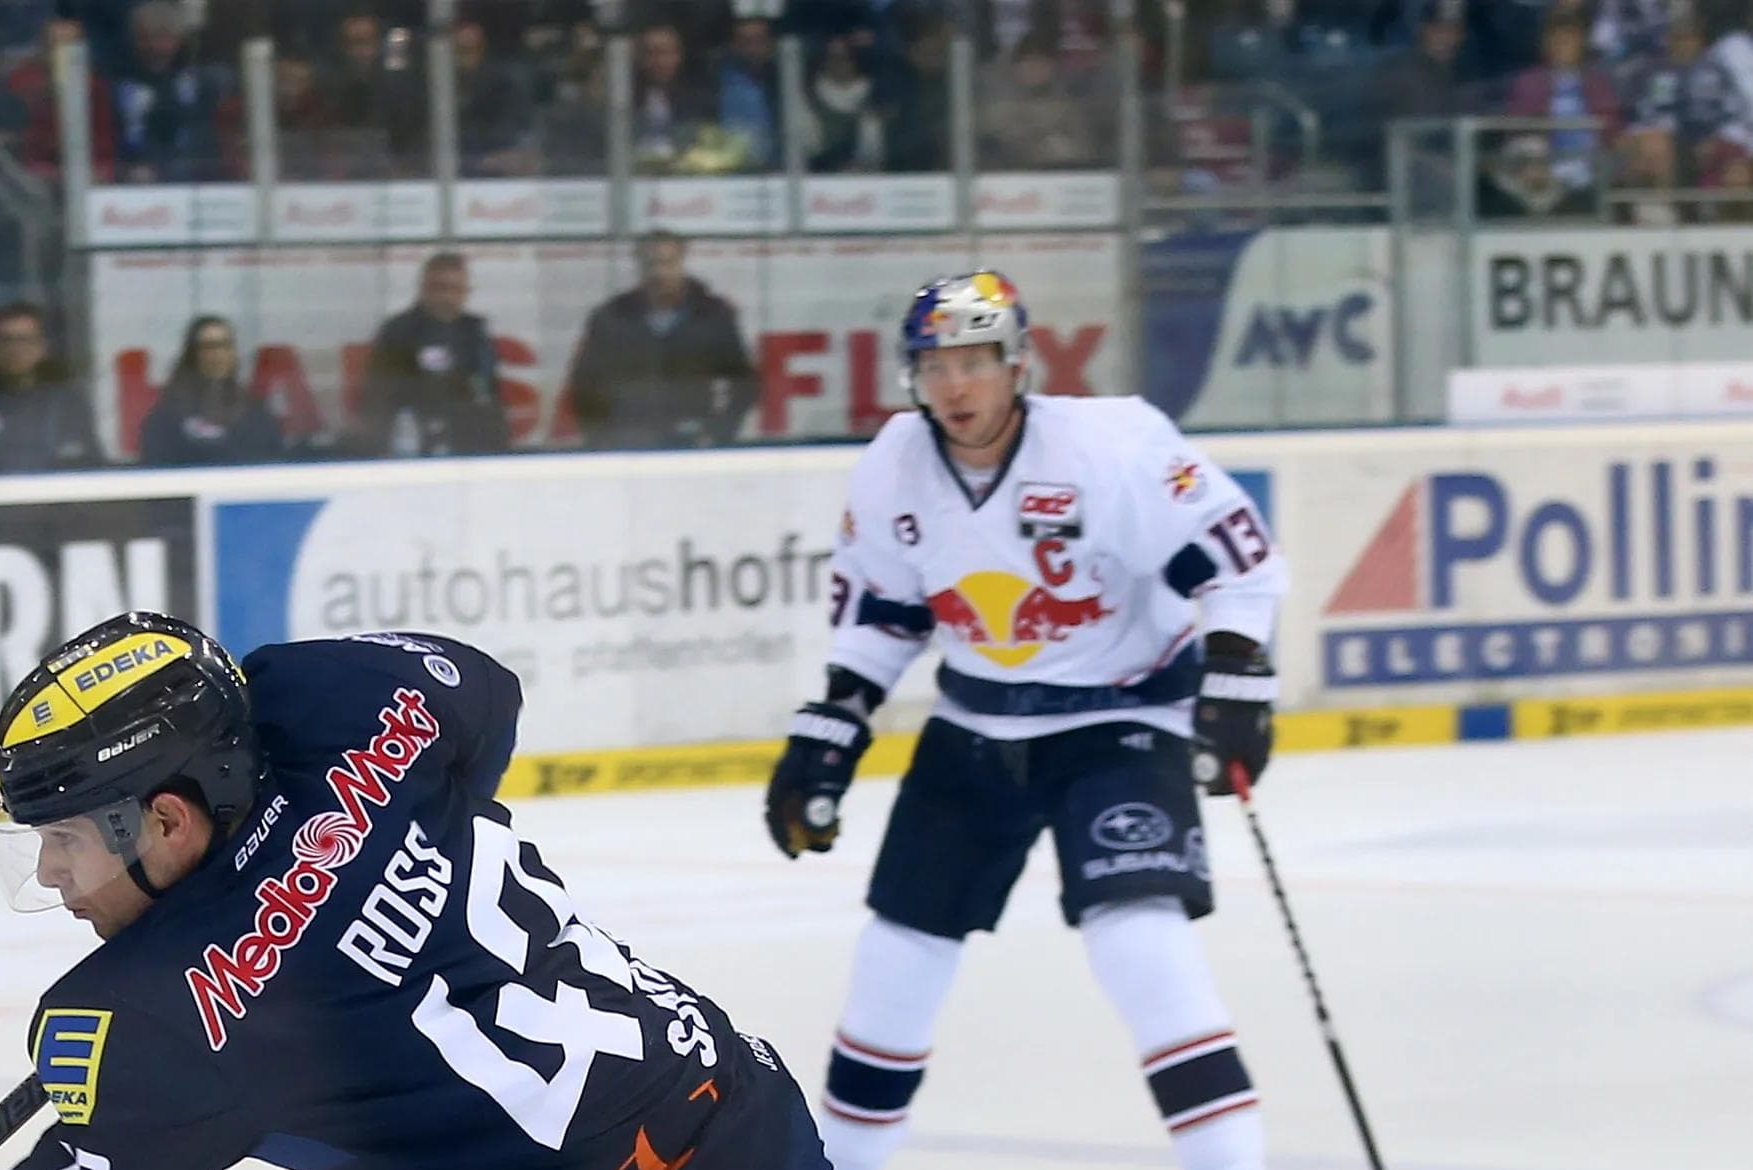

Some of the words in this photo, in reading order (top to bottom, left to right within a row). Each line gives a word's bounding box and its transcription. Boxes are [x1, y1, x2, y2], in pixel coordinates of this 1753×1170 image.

[758, 324, 1108, 436] FLX
[1033, 538, 1075, 586] C
[1208, 506, 1270, 574] 13
[74, 639, 175, 693] EDEKA
[336, 819, 453, 988] ROSS
[410, 814, 644, 1151] 42
